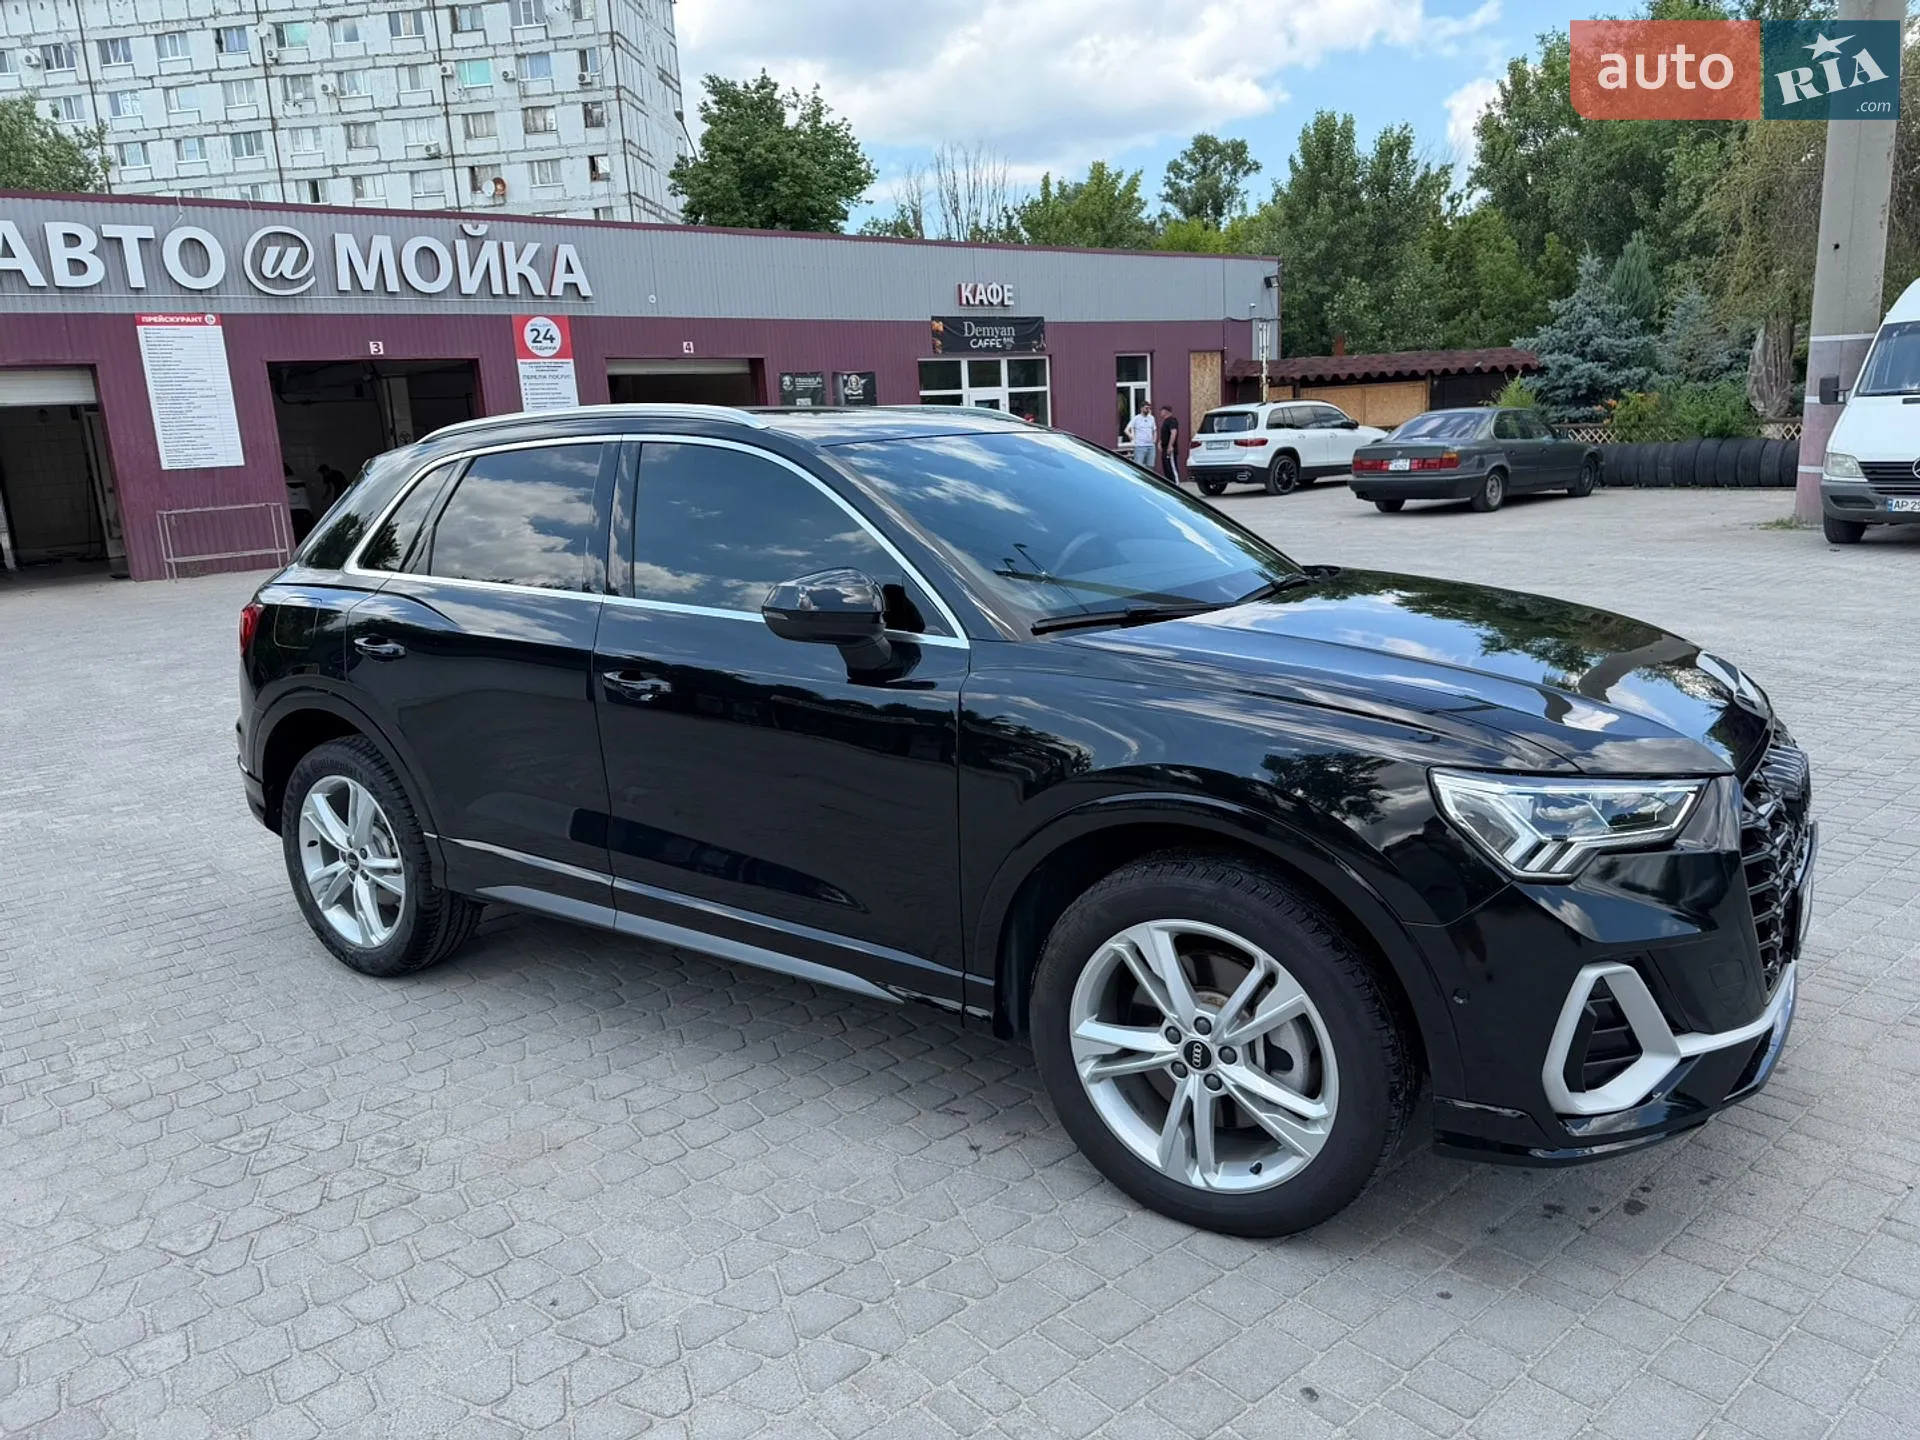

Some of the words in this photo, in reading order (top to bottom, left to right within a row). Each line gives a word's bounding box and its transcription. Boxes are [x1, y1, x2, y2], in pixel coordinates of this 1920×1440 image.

[0, 220, 226, 291] АВТО
[333, 223, 594, 298] МОЙКА
[959, 281, 1015, 306] КАФЕ
[530, 327, 556, 344] 24
[963, 321, 1016, 338] Demyan
[372, 342, 382, 354] 3
